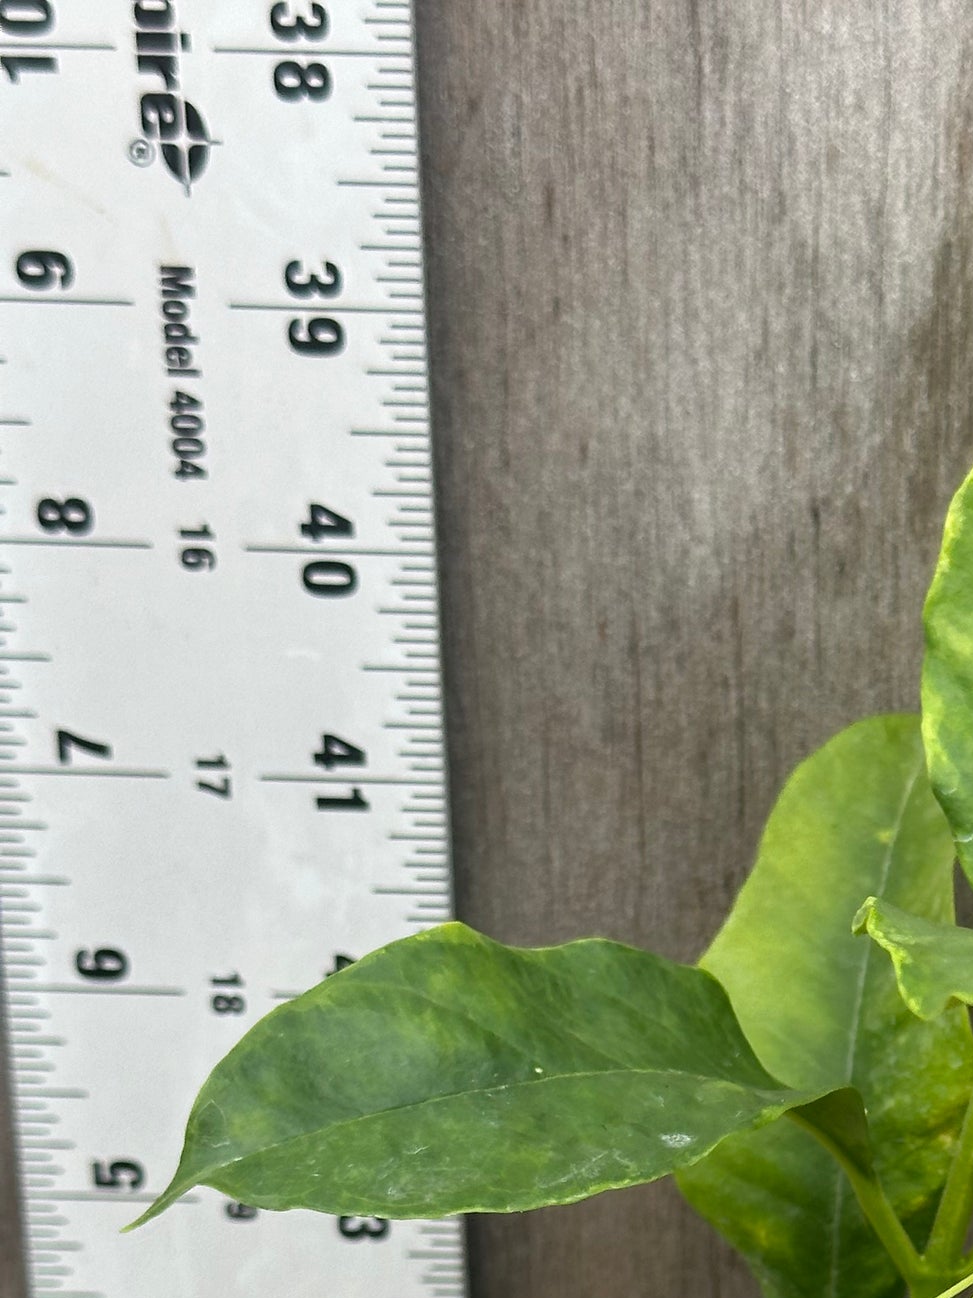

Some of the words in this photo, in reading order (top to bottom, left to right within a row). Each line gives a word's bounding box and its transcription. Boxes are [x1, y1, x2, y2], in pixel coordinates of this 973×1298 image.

[0, 0, 58, 84] 10
[270, 2, 332, 102] 38
[16, 250, 74, 290] 9
[160, 266, 201, 377] Model
[285, 260, 344, 356] 39
[169, 391, 207, 480] 4004
[38, 498, 92, 535] 8
[180, 524, 216, 571] 16
[300, 503, 357, 597] 40
[55, 730, 112, 764] 7
[195, 754, 232, 800] 17
[313, 734, 369, 813] 41
[76, 948, 128, 980] 6
[209, 972, 246, 1016] 18
[94, 1159, 146, 1190] 5
[338, 1215, 390, 1240] 3
